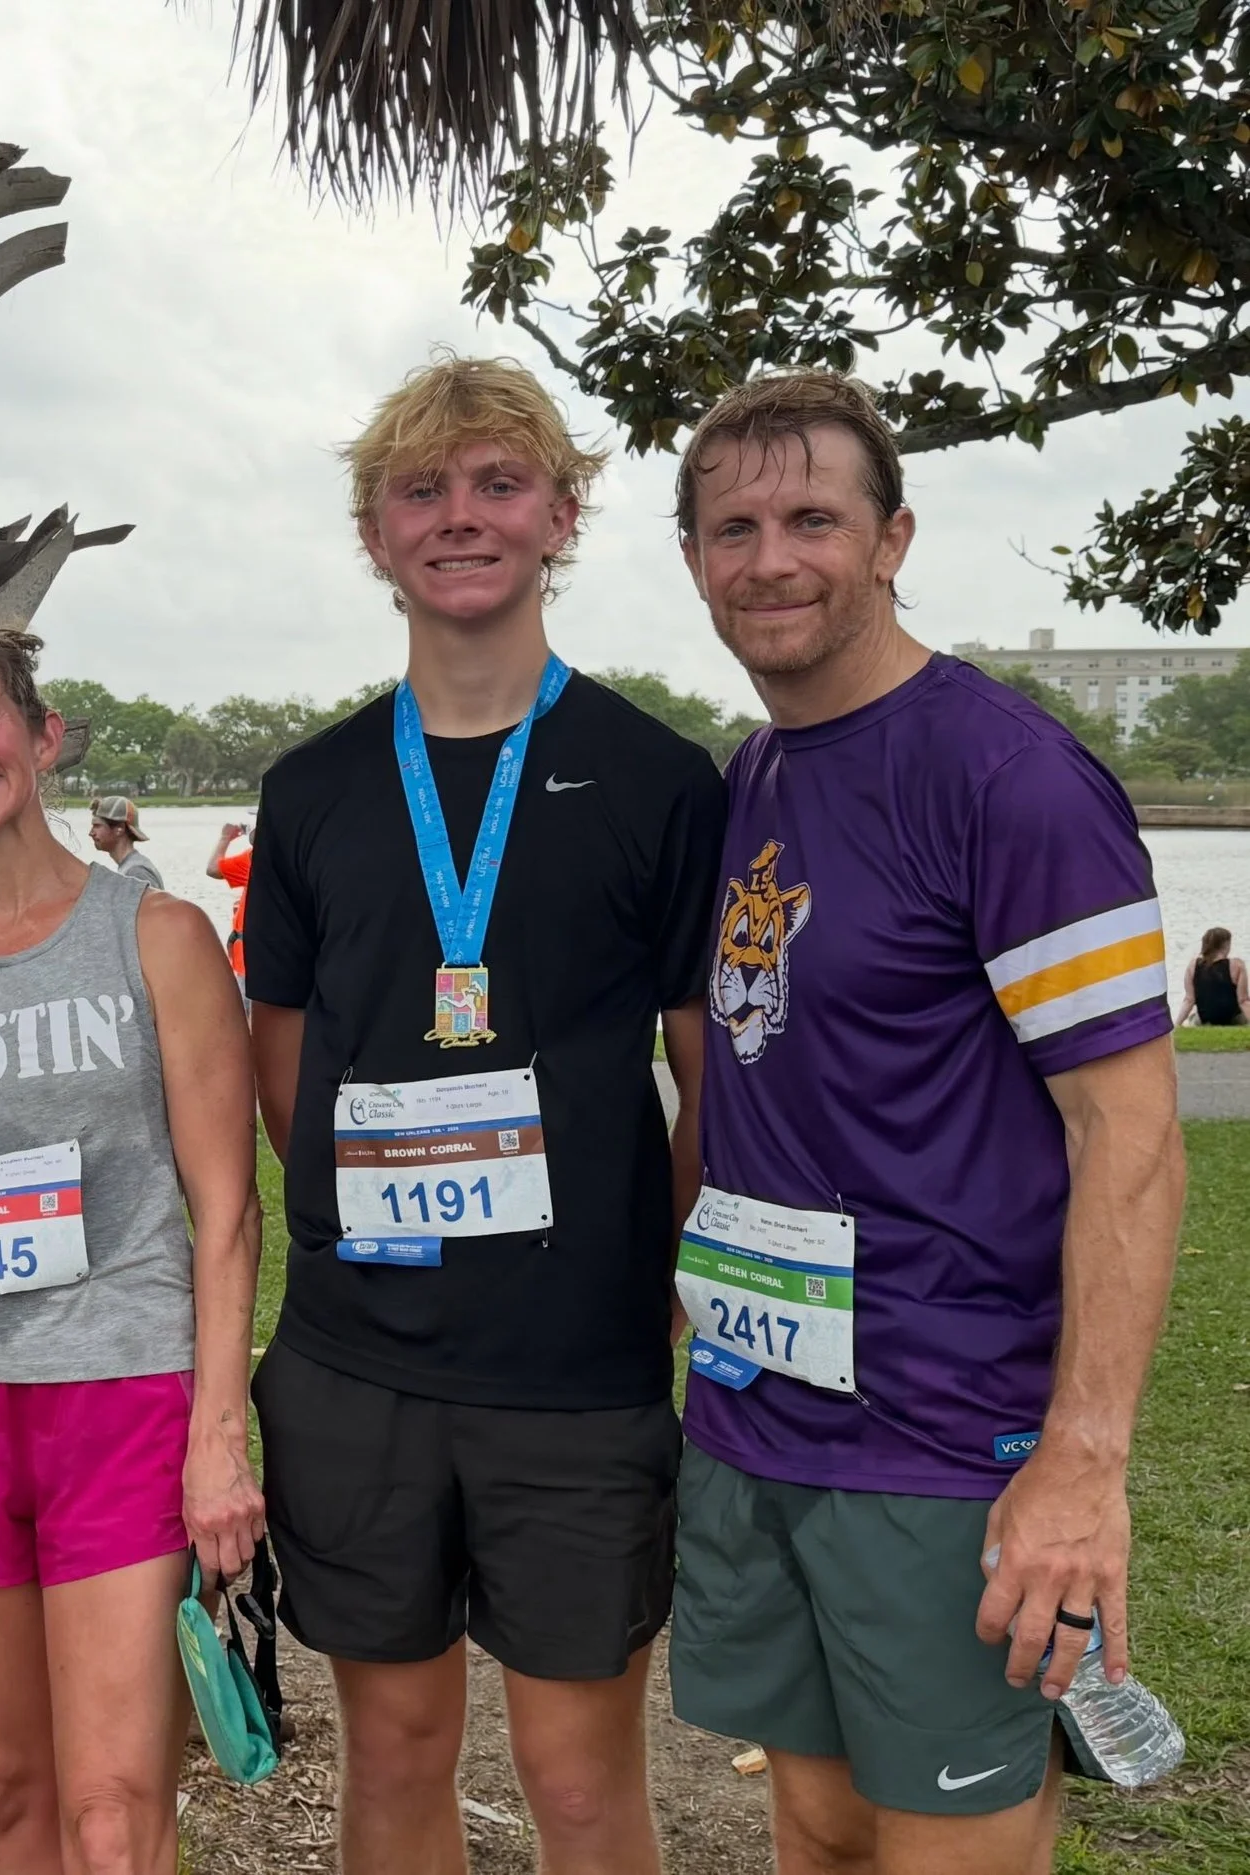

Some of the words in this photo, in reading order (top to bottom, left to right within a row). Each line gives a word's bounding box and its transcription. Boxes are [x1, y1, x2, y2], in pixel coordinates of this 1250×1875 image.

[491, 812, 500, 834] NOLA
[478, 846, 492, 877] ULTRA
[369, 1109, 396, 1118] Classic
[384, 1147, 426, 1158] BROWN
[430, 1142, 476, 1154] CORRAL
[381, 1176, 493, 1223] 1191
[717, 1263, 748, 1279] GREEN
[750, 1271, 784, 1289] CORRAL
[710, 1298, 800, 1362] 2417
